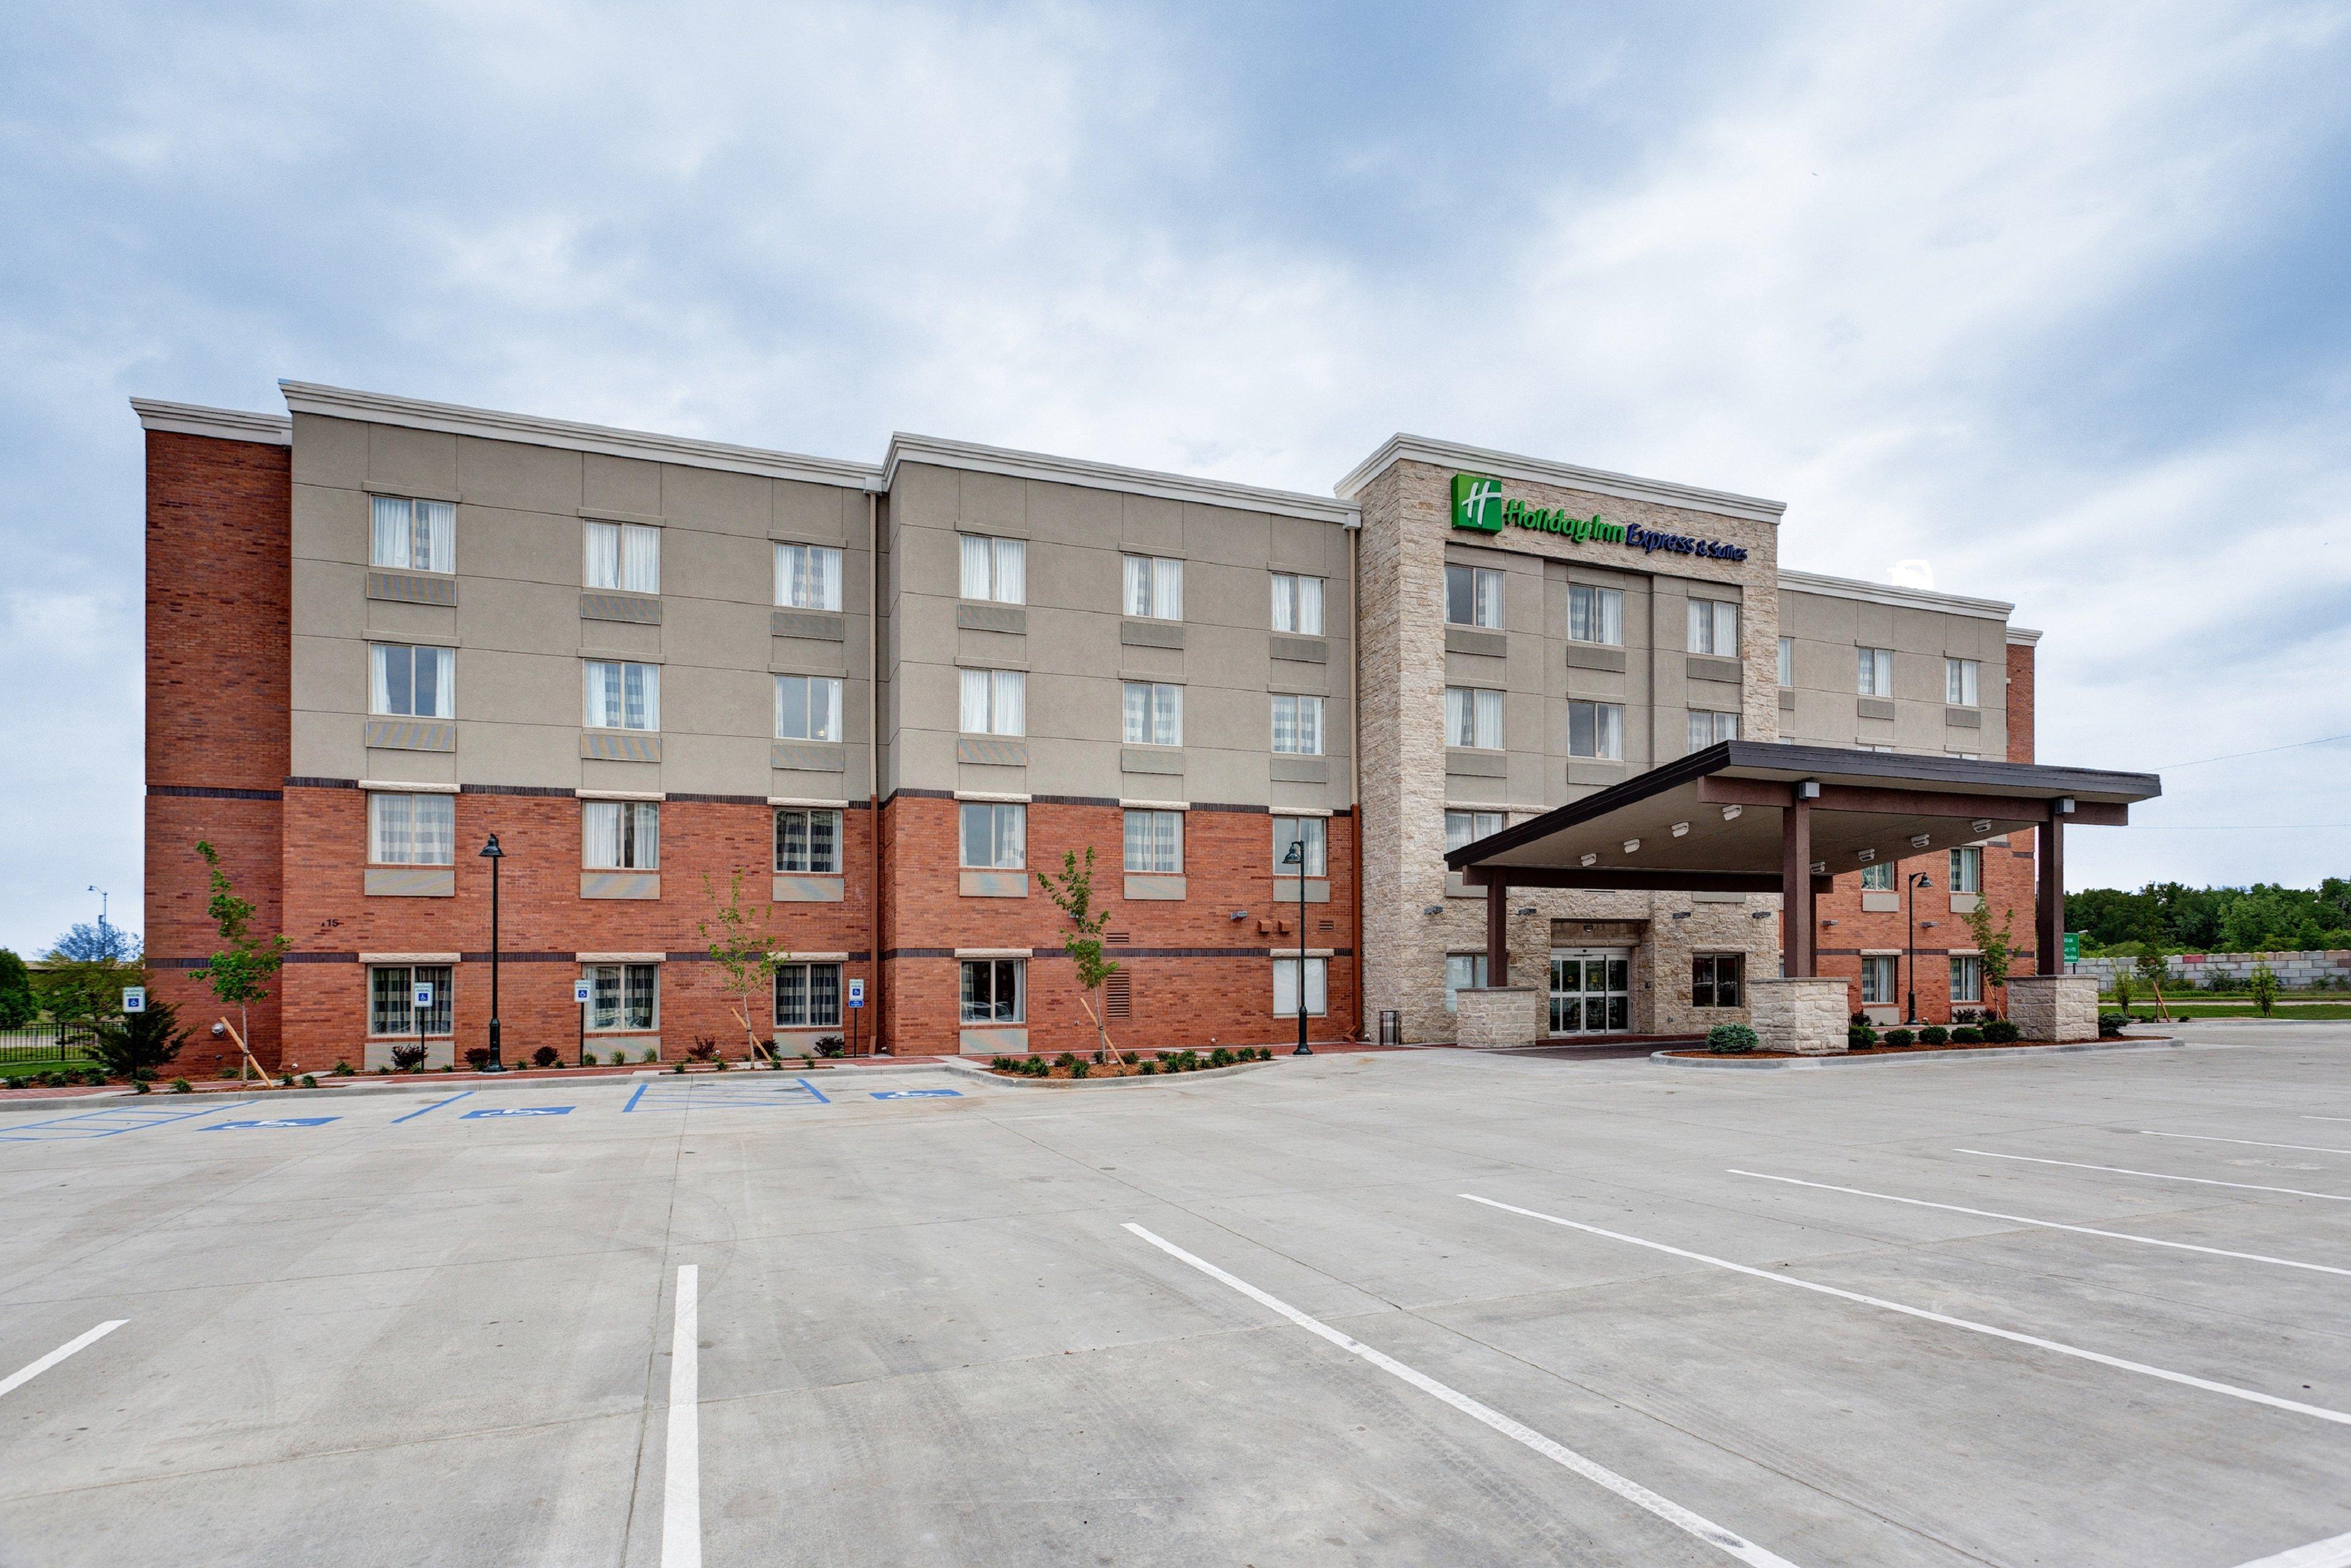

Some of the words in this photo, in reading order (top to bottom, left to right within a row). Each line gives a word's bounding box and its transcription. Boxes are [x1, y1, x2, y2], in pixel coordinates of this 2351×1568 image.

[1504, 498, 1590, 544] Holiday
[1590, 514, 1625, 542] Inn
[1625, 523, 1696, 554] Express
[1695, 539, 1708, 557] &
[1708, 541, 1749, 561] Suites
